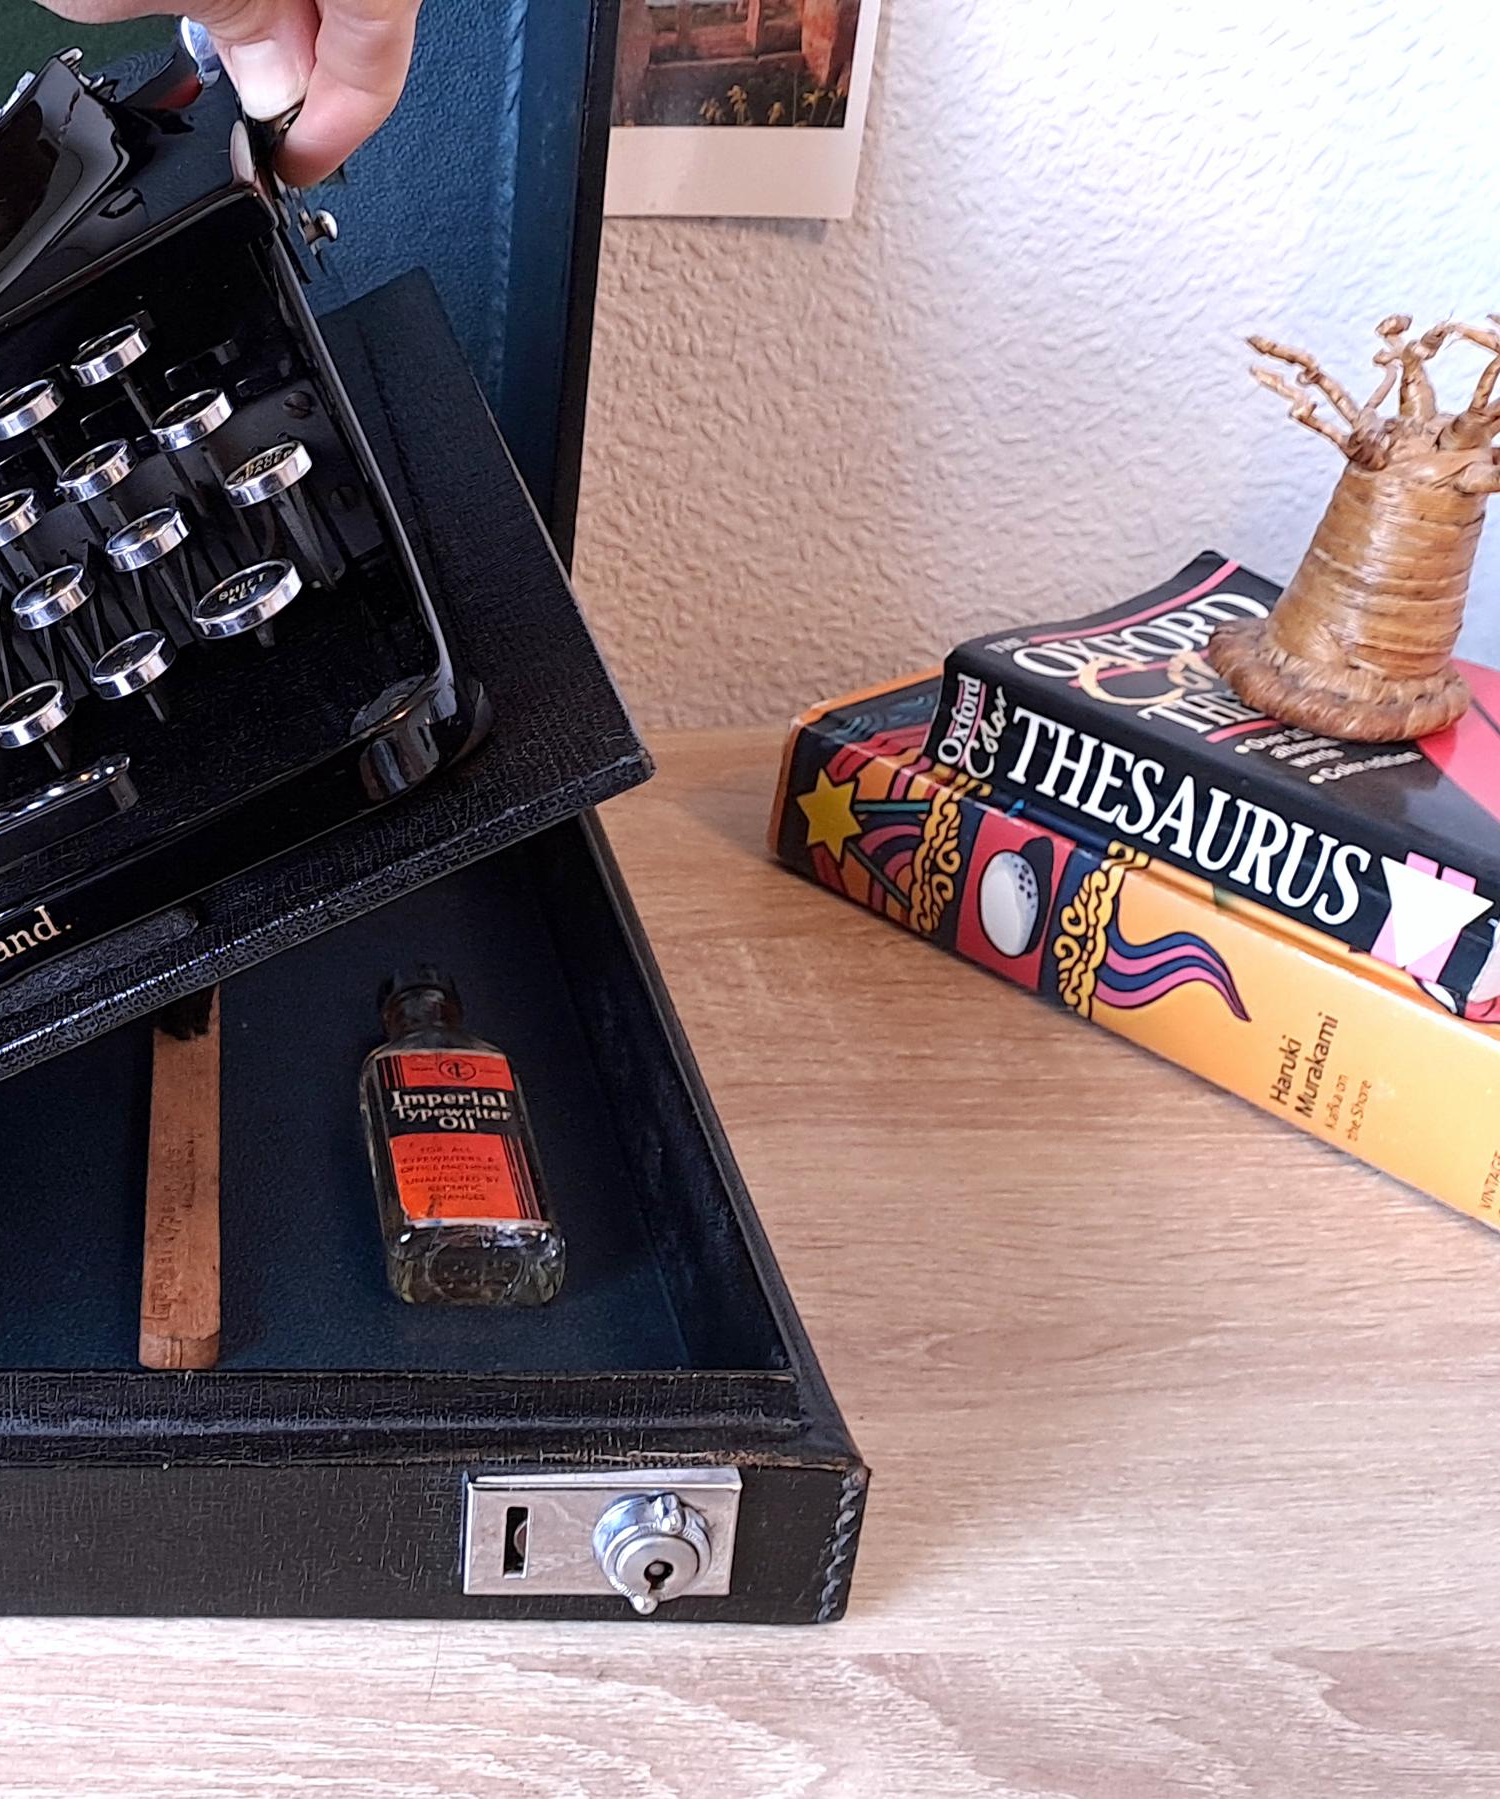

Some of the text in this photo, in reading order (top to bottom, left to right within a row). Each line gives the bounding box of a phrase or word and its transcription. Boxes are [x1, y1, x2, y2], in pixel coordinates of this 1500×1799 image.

[218, 571, 267, 602] SHIFT
[228, 584, 259, 606] KEY
[1013, 592, 1270, 678] OXFORD
[938, 672, 981, 765] Oxford
[1007, 706, 1371, 926] THESAURUS
[1269, 1034, 1303, 1106] Haruki
[1295, 1011, 1339, 1119] Murakami
[391, 1090, 508, 1107] Imperial
[391, 1105, 512, 1122] Typewriter
[1352, 1079, 1372, 1121] Shore
[438, 1116, 477, 1130] Oil
